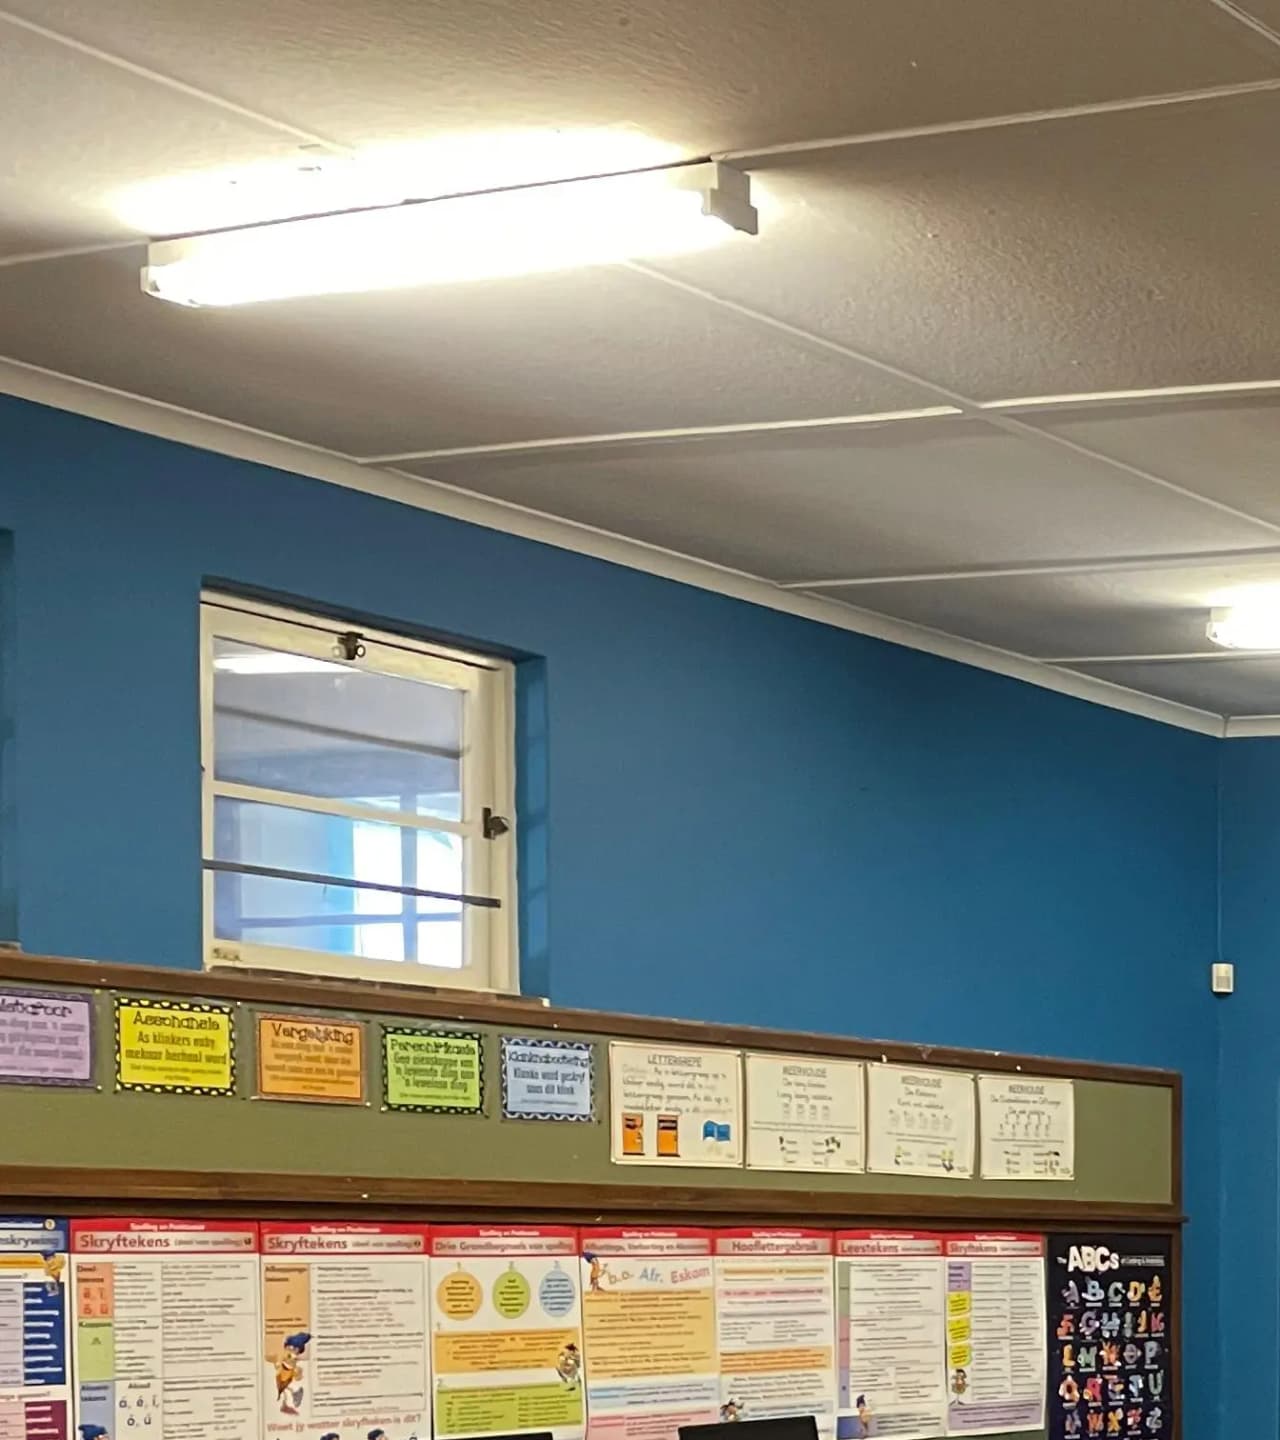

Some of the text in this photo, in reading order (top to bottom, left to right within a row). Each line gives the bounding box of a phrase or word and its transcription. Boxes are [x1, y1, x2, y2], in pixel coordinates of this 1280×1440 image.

[80, 1233, 170, 1252] Skryftekens
[268, 1236, 348, 1254] Skryftekens
[840, 1242, 899, 1254] Leestekens
[1067, 1245, 1120, 1273] ABCs
[670, 1266, 711, 1284] Eskom
[1144, 1341, 1160, 1365] P
[1148, 1371, 1163, 1396] U
